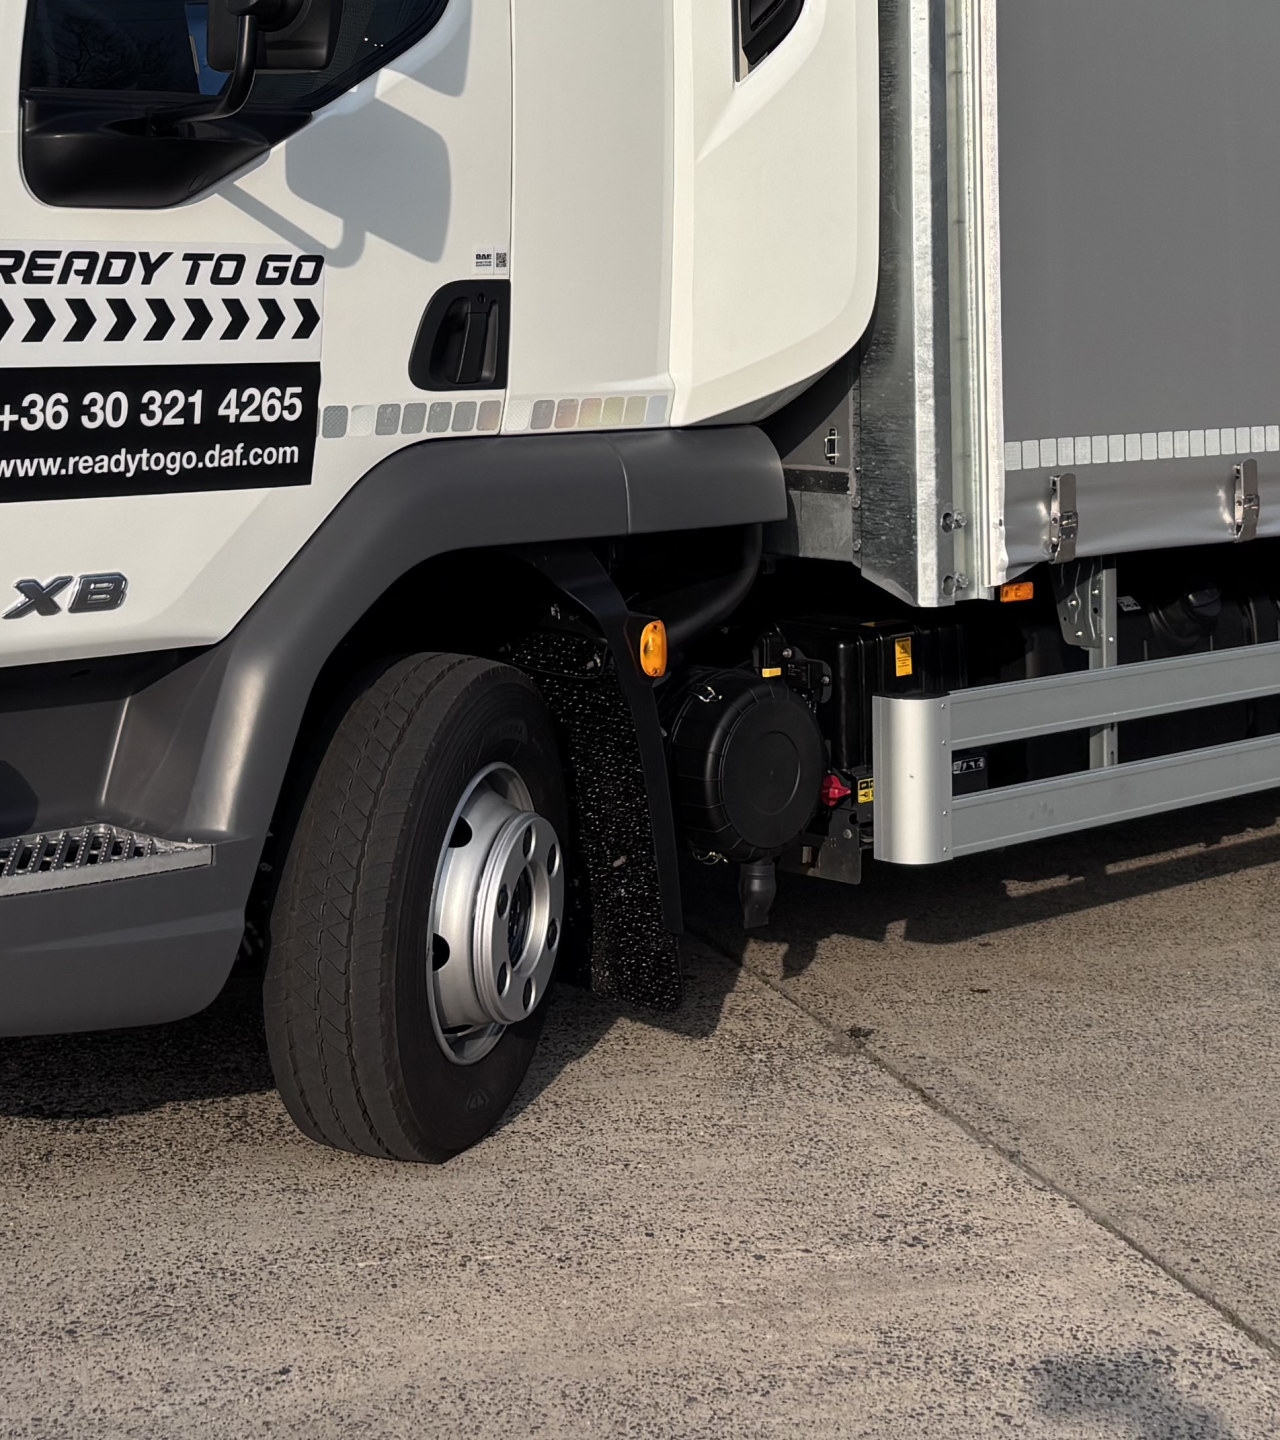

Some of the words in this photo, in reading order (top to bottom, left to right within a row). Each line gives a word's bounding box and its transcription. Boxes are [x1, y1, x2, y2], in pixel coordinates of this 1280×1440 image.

[181, 253, 246, 285] TO
[255, 254, 325, 285] GO
[81, 391, 128, 429] 30
[140, 389, 203, 427] 321
[217, 387, 303, 423] 4265
[1, 571, 129, 620] XB
